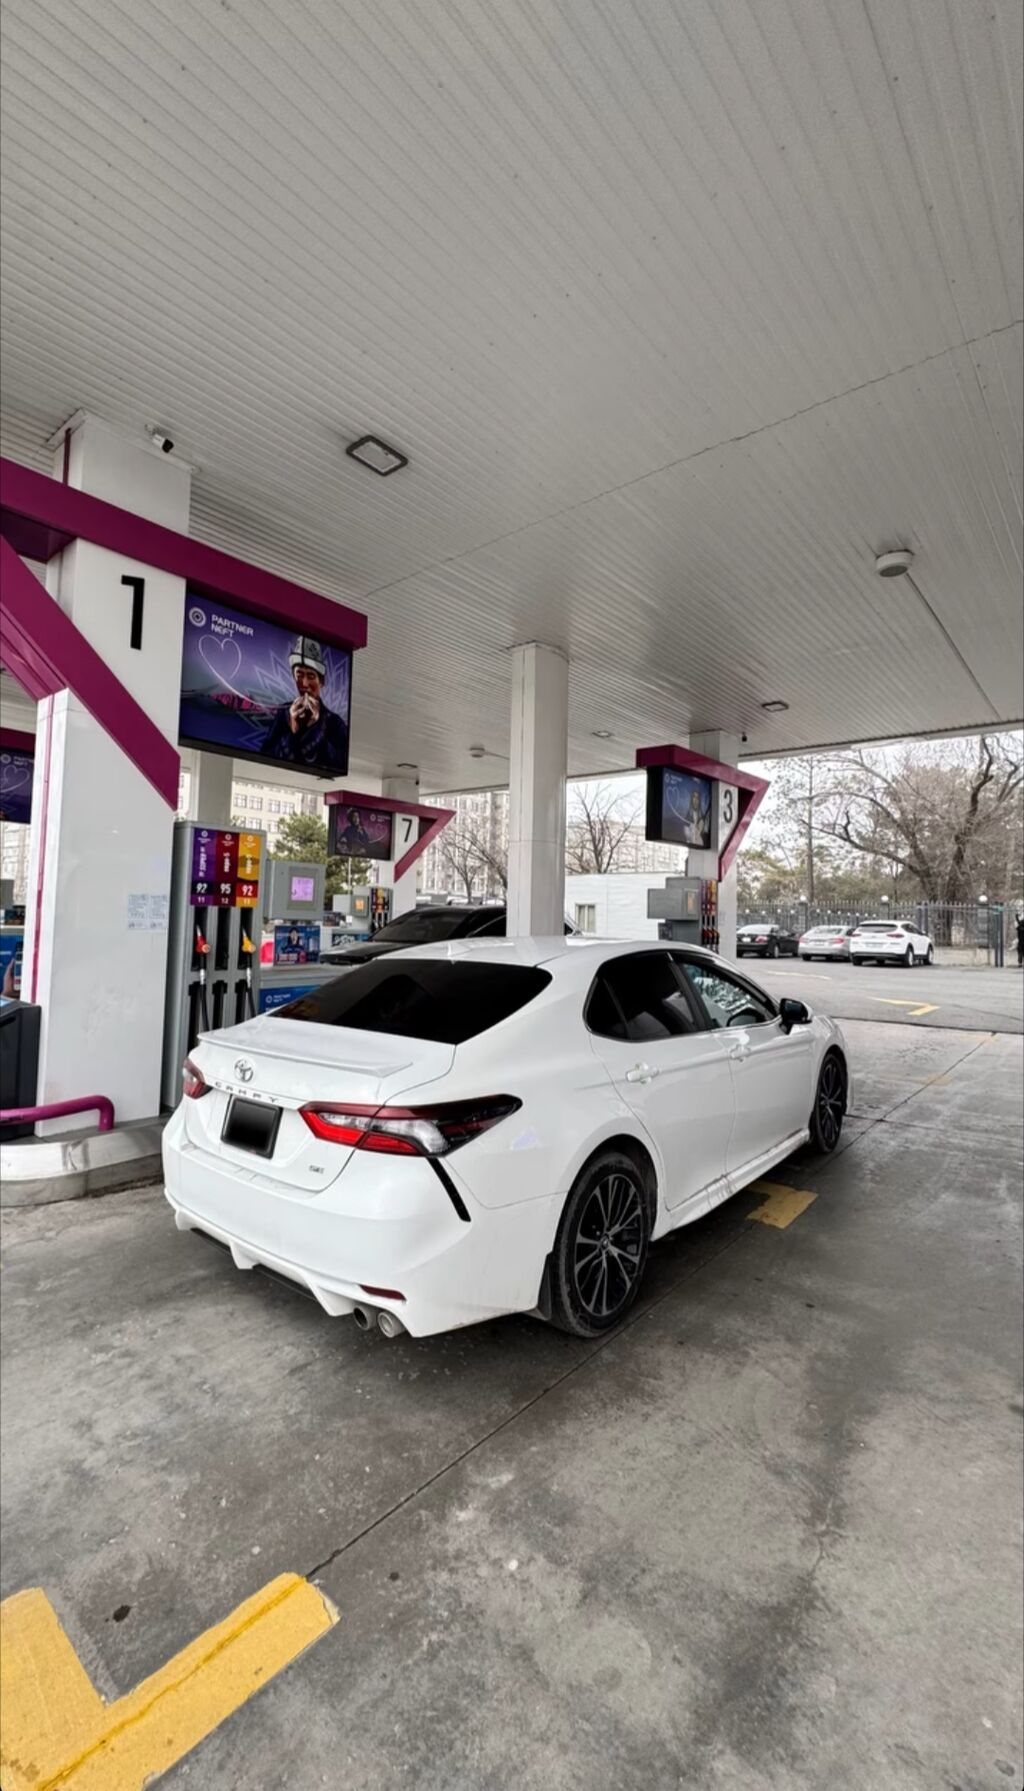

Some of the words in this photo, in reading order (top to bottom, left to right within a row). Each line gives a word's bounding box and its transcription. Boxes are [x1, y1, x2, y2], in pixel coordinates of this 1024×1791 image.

[121, 575, 145, 650] 1
[211, 614, 254, 637] PARTNER
[211, 623, 235, 637] NEFT
[723, 789, 733, 823] 3
[402, 818, 412, 843] 7
[196, 883, 208, 893] 92
[220, 883, 232, 895] 95
[242, 885, 254, 897] 92
[215, 1081, 279, 1103] CAMRY
